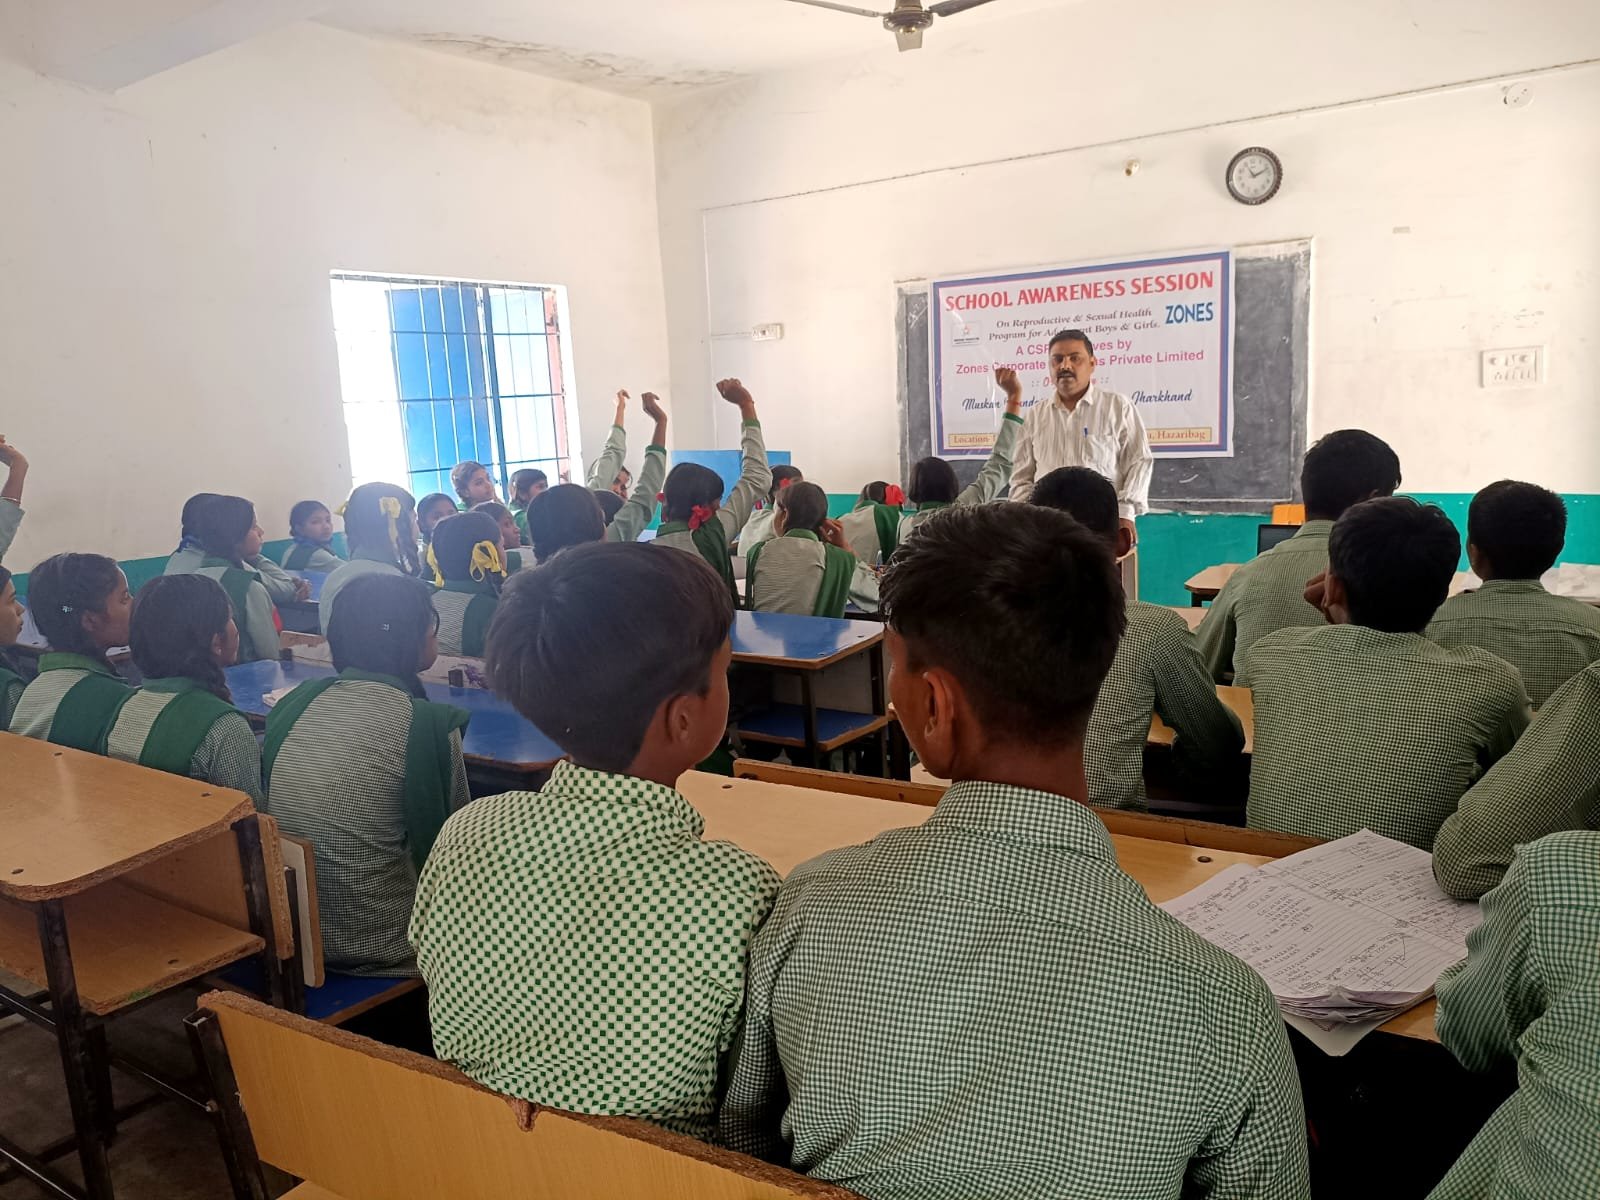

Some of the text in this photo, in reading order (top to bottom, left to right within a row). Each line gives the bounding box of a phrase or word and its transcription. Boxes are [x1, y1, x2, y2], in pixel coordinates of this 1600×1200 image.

[945, 271, 1214, 311] SCHOOL AWARENESS SESSION
[996, 307, 1153, 329] On Reproductive & Sexual Health
[1165, 302, 1214, 324] ZONES
[988, 331, 1027, 343] Program
[1027, 328, 1042, 341] for
[1094, 324, 1118, 336] Boys
[1120, 322, 1131, 331] &
[1015, 346, 1024, 356] A
[1116, 339, 1132, 351] by
[956, 363, 989, 374] Zones
[992, 361, 1046, 373] Corporate
[1109, 353, 1153, 366] Private
[1156, 350, 1205, 363] Limited
[1157, 428, 1206, 441] Hazaribag
